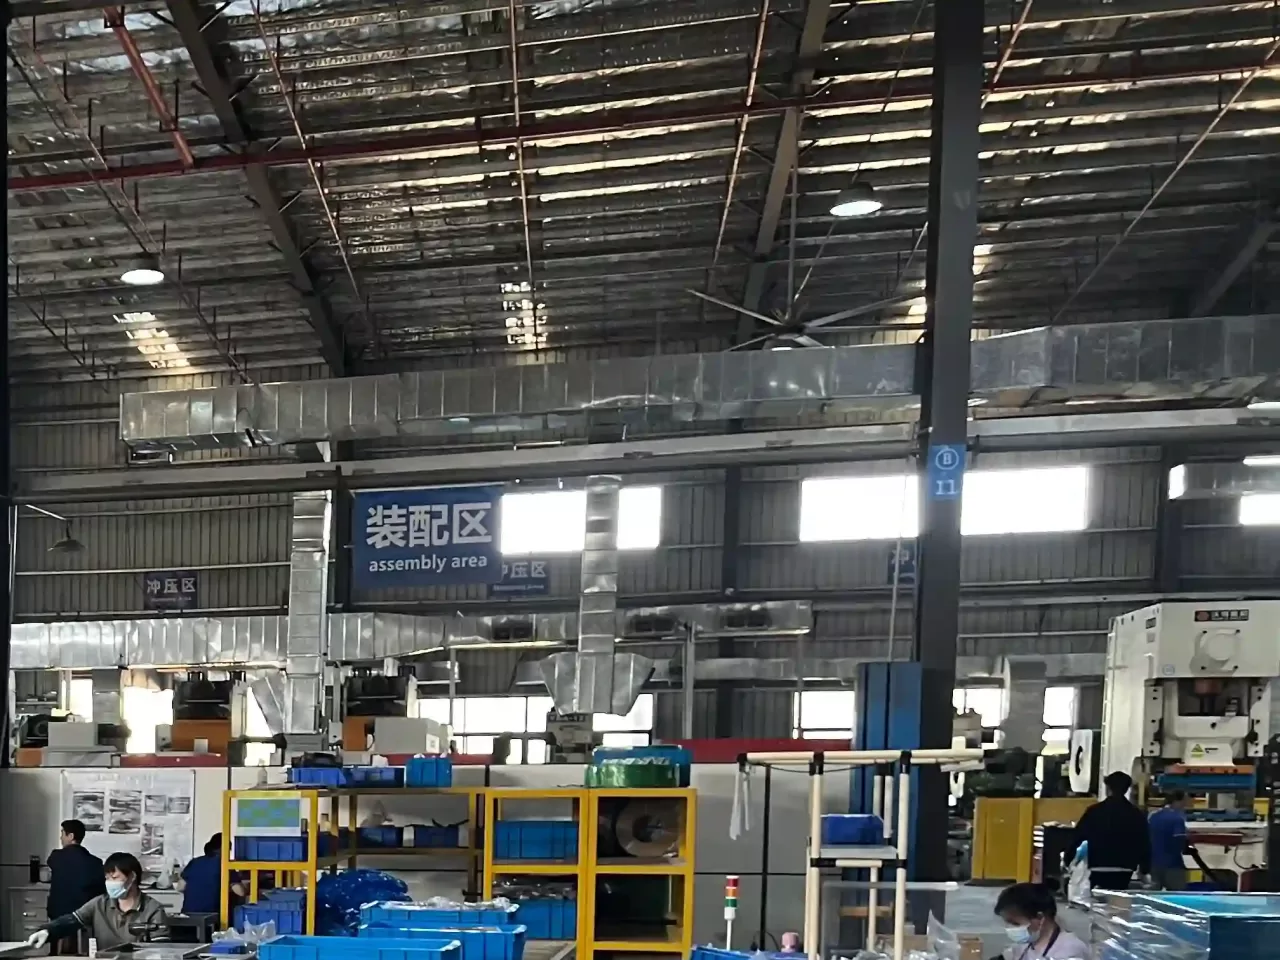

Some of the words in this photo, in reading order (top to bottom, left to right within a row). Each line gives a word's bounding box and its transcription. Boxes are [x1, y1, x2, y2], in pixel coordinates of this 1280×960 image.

[366, 502, 492, 549] 装配区
[369, 554, 447, 573] assembly
[452, 555, 488, 569] area
[146, 577, 196, 594] 冲压区
